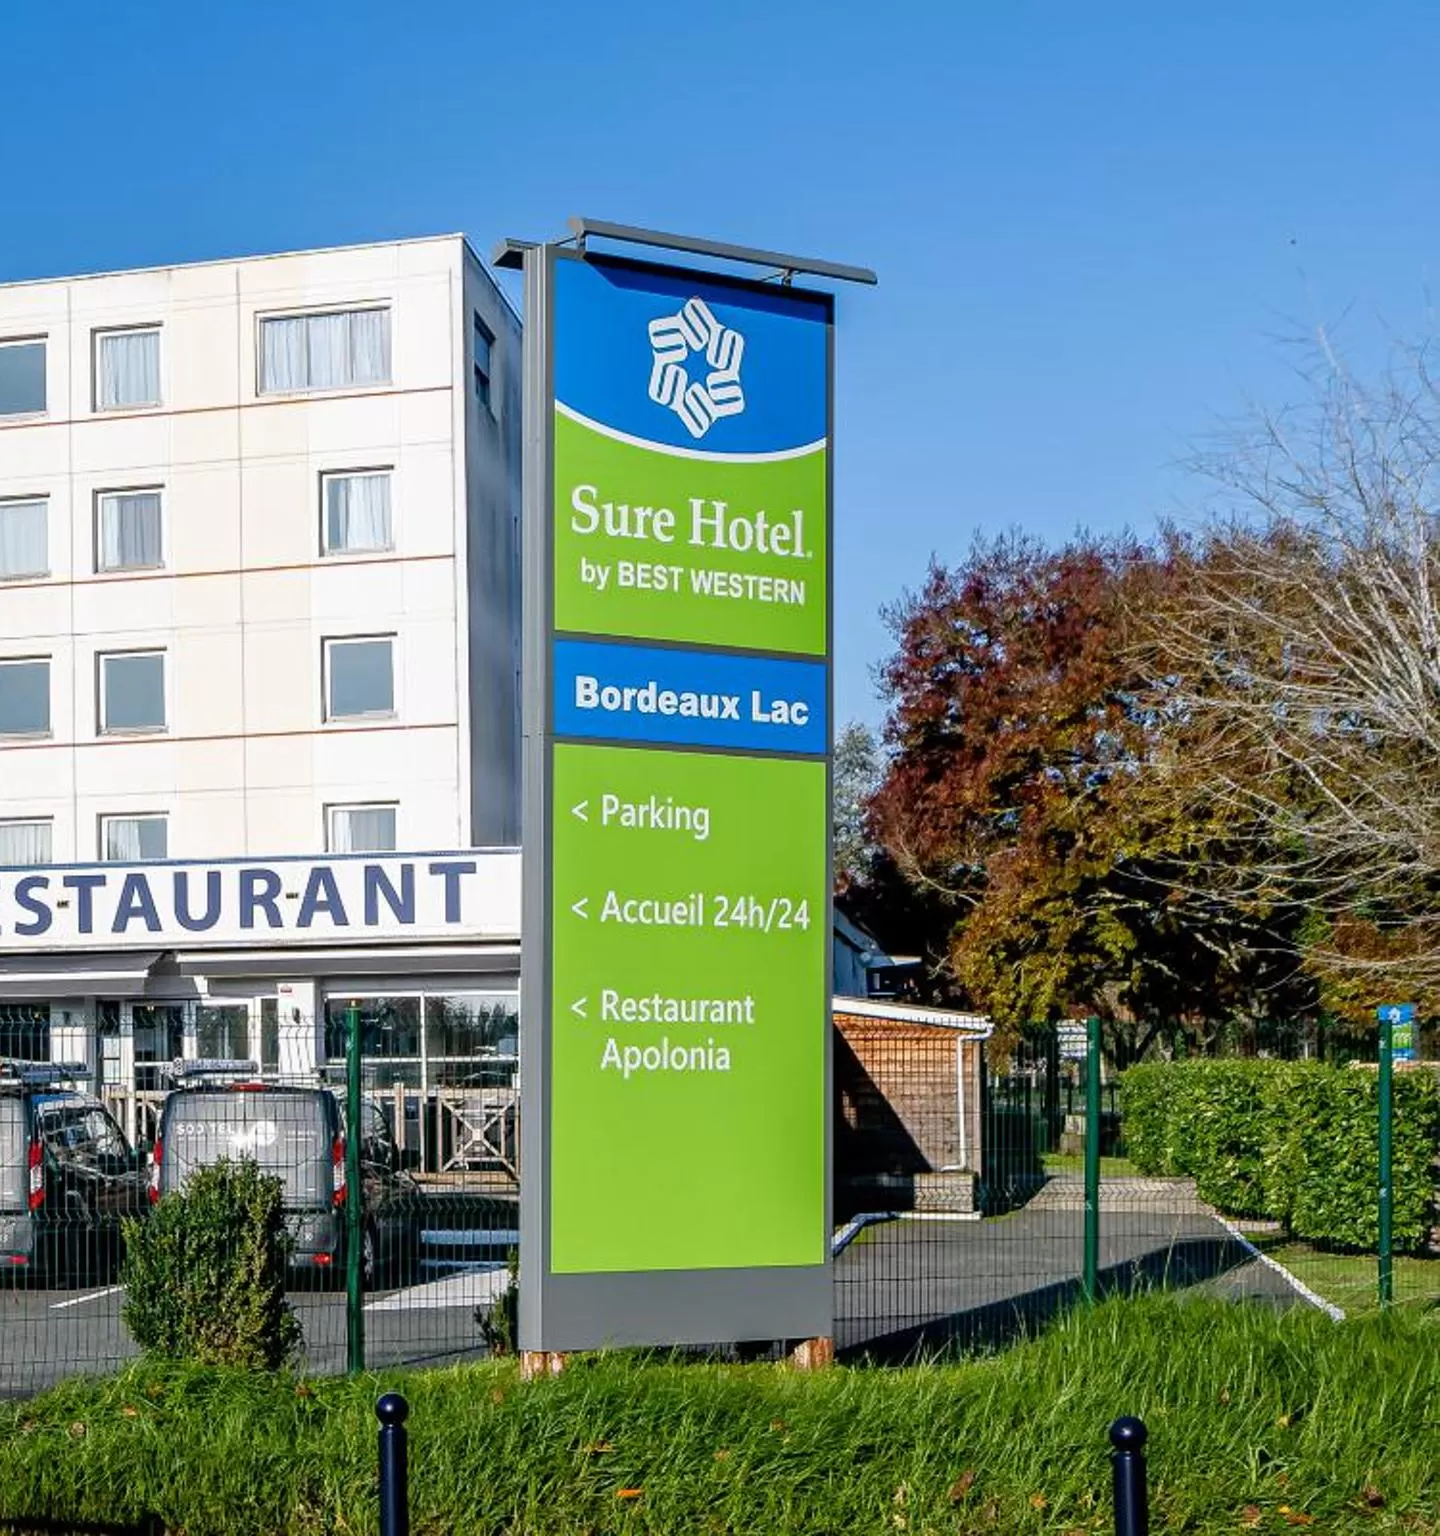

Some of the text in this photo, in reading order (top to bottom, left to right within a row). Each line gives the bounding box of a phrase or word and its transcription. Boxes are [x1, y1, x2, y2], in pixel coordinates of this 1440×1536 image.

[571, 484, 805, 558] Sure Hotel
[580, 557, 806, 606] by BEST WESTERN
[575, 675, 809, 726] Bordeaux Lac
[601, 794, 710, 841] Parking
[600, 890, 810, 933] Accueil 24h/24
[601, 988, 755, 1024] Restaurant
[600, 1036, 731, 1080] Apolonia
